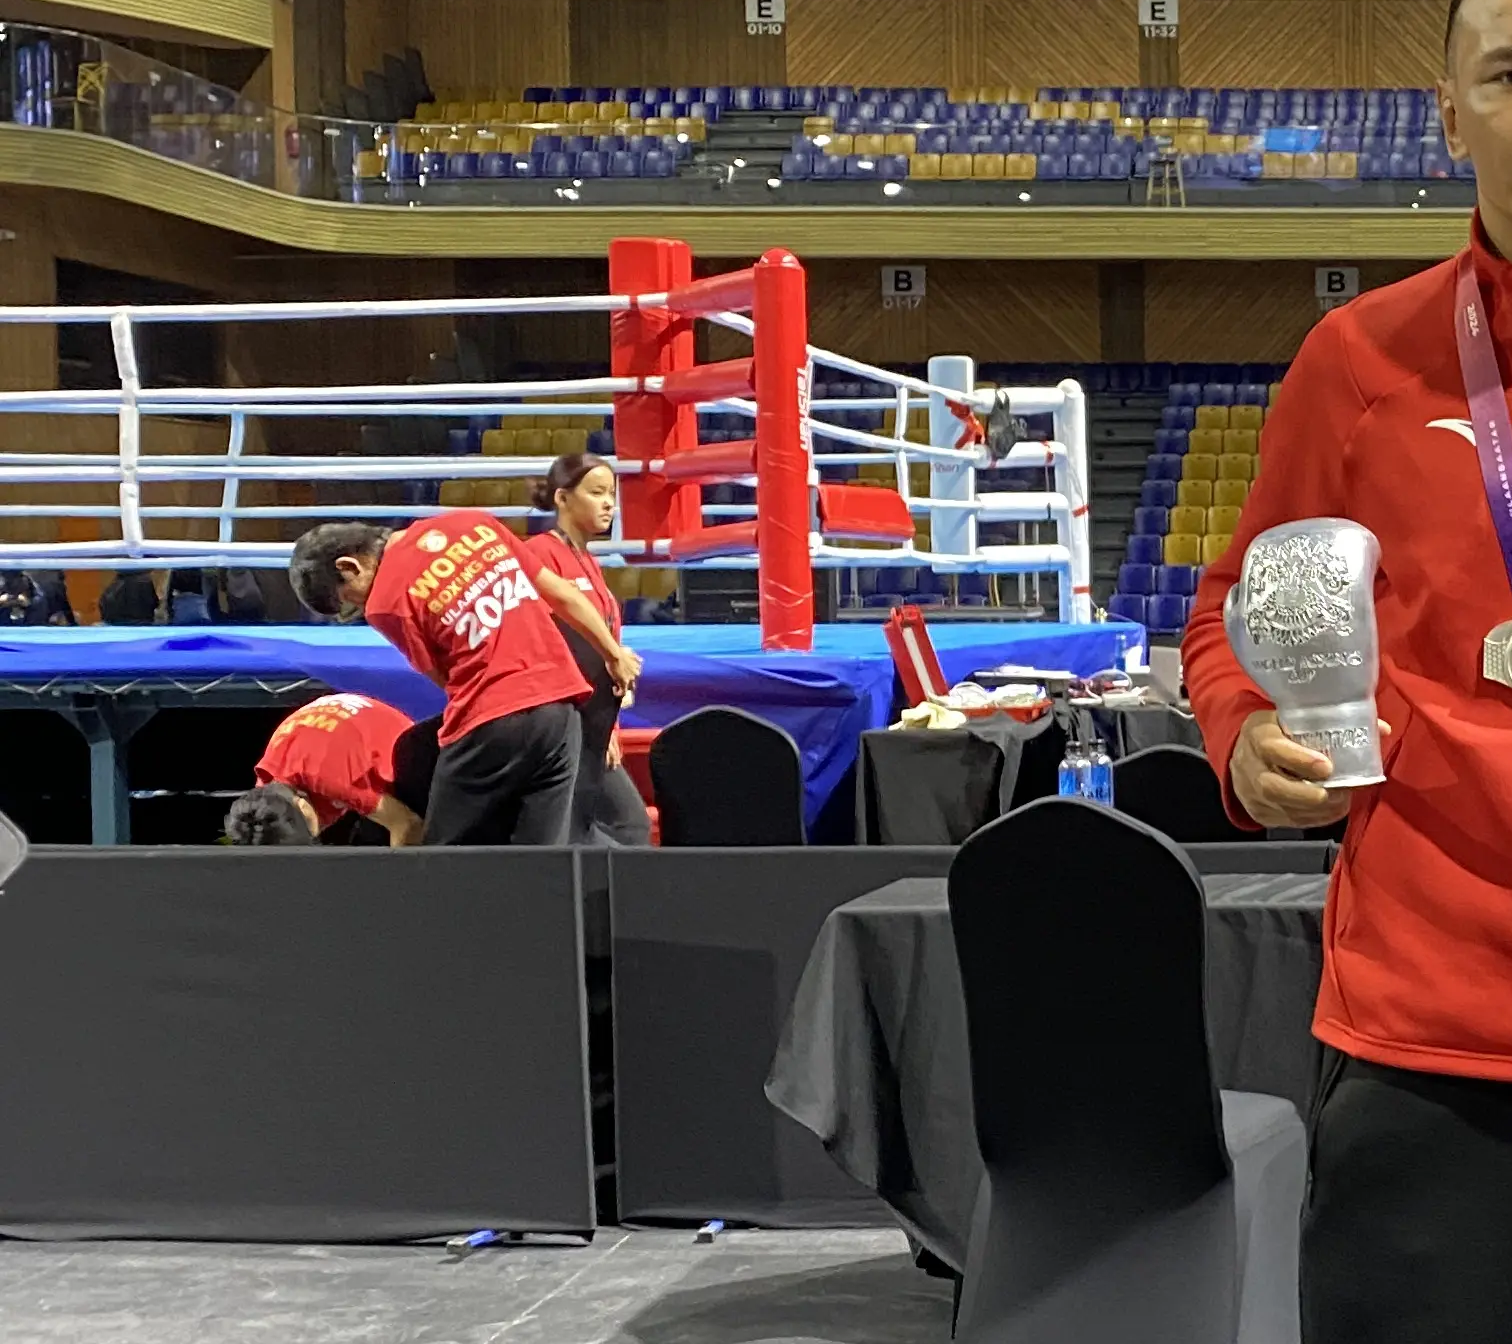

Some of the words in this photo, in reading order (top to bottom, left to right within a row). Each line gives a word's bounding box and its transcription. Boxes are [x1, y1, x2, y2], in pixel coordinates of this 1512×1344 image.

[757, 0, 772, 18] E
[1151, 1, 1165, 21] E
[747, 23, 782, 35] 01-10
[895, 271, 912, 291] B
[1328, 272, 1345, 293] B
[408, 525, 498, 600] WORLD
[427, 560, 484, 614] BOXING
[454, 569, 540, 650] 2024
